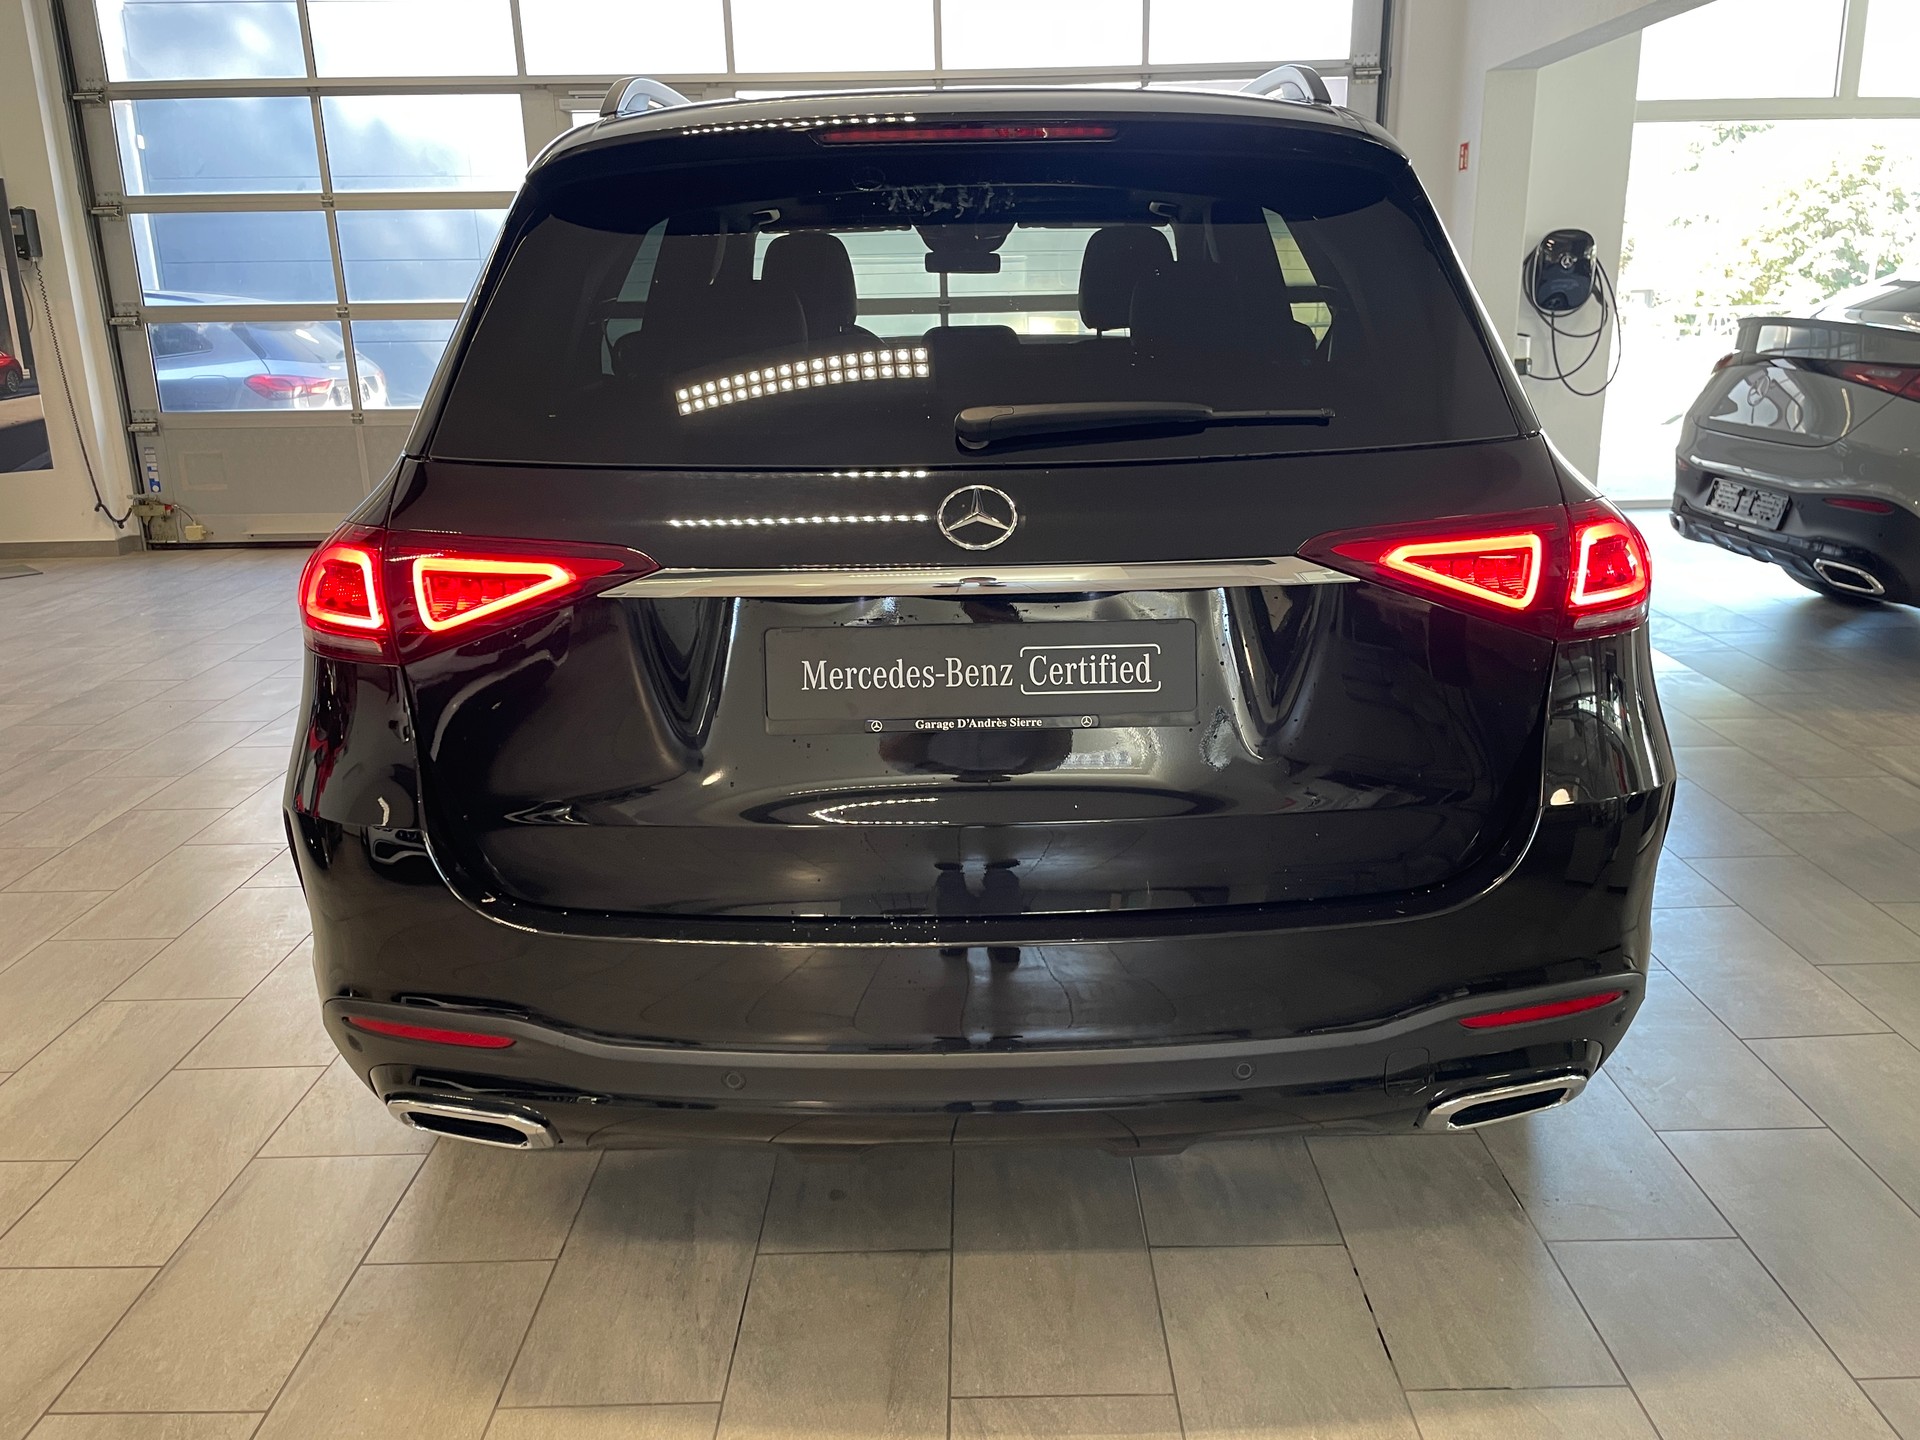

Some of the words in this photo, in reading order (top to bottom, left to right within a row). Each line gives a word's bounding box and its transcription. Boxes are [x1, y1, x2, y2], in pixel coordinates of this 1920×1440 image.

[801, 658, 1013, 690] Mercedes-Benz
[1029, 654, 1152, 686] Certified
[915, 719, 954, 730] Garage
[957, 718, 1007, 728] D'Andrès
[1009, 717, 1042, 727] Sierre
